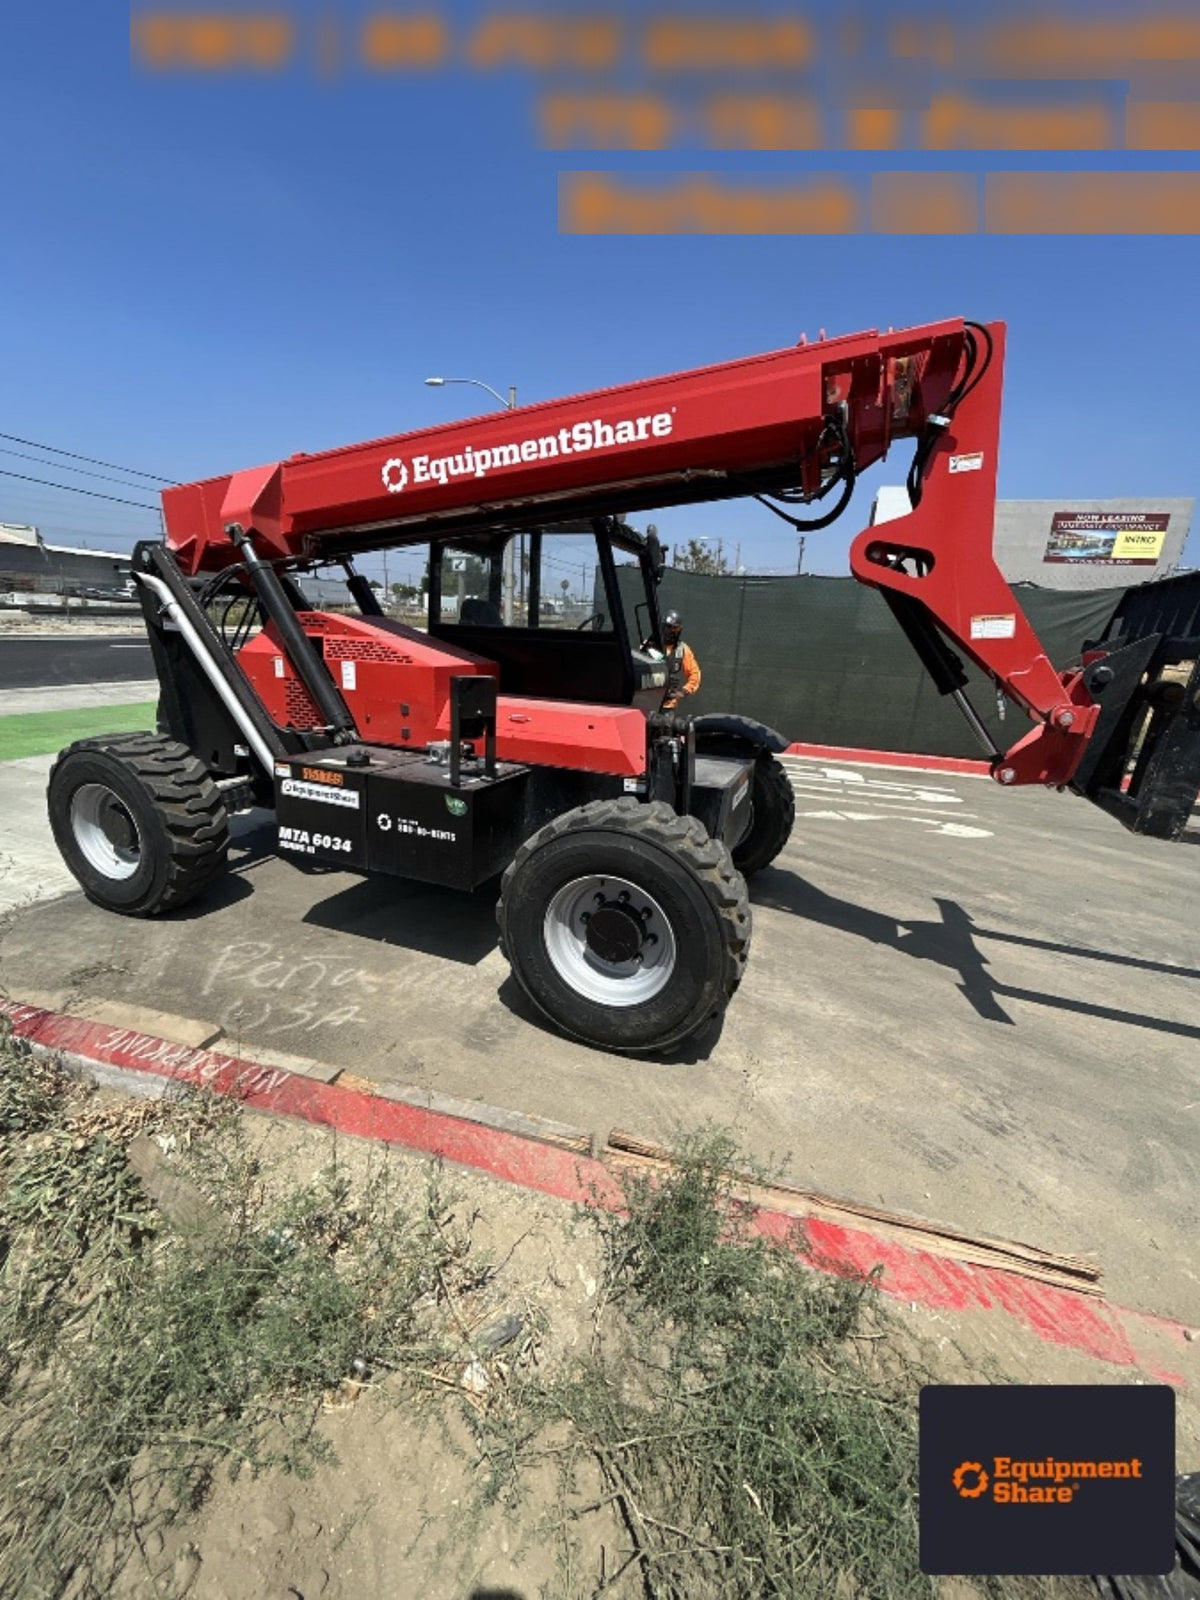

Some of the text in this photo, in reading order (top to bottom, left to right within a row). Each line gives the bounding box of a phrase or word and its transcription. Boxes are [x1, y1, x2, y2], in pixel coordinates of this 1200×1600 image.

[412, 411, 673, 484] EquipmentShare
[1076, 513, 1099, 521] NOW
[279, 826, 309, 844] MTA
[312, 833, 352, 852] 6034
[96, 1029, 233, 1078] PARKING
